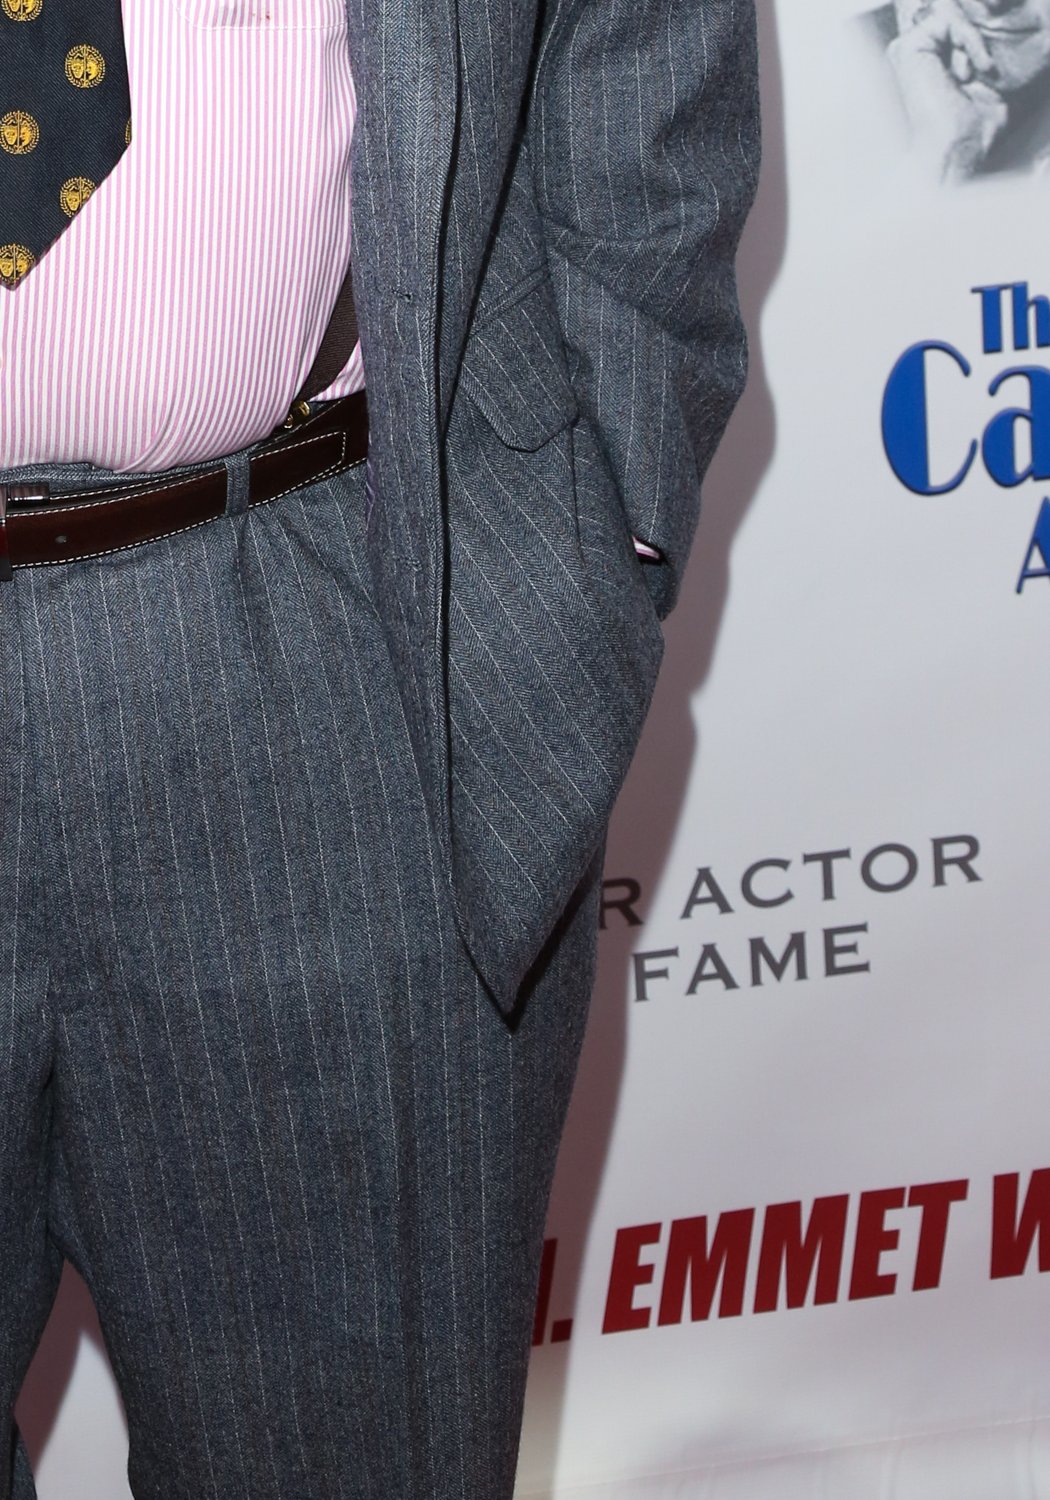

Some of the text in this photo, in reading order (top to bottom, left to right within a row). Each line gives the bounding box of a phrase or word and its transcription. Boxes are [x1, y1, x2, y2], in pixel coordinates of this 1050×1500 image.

[680, 834, 983, 919] ACTOR
[632, 922, 871, 1002] FAME
[601, 1179, 969, 1335] EMMET
